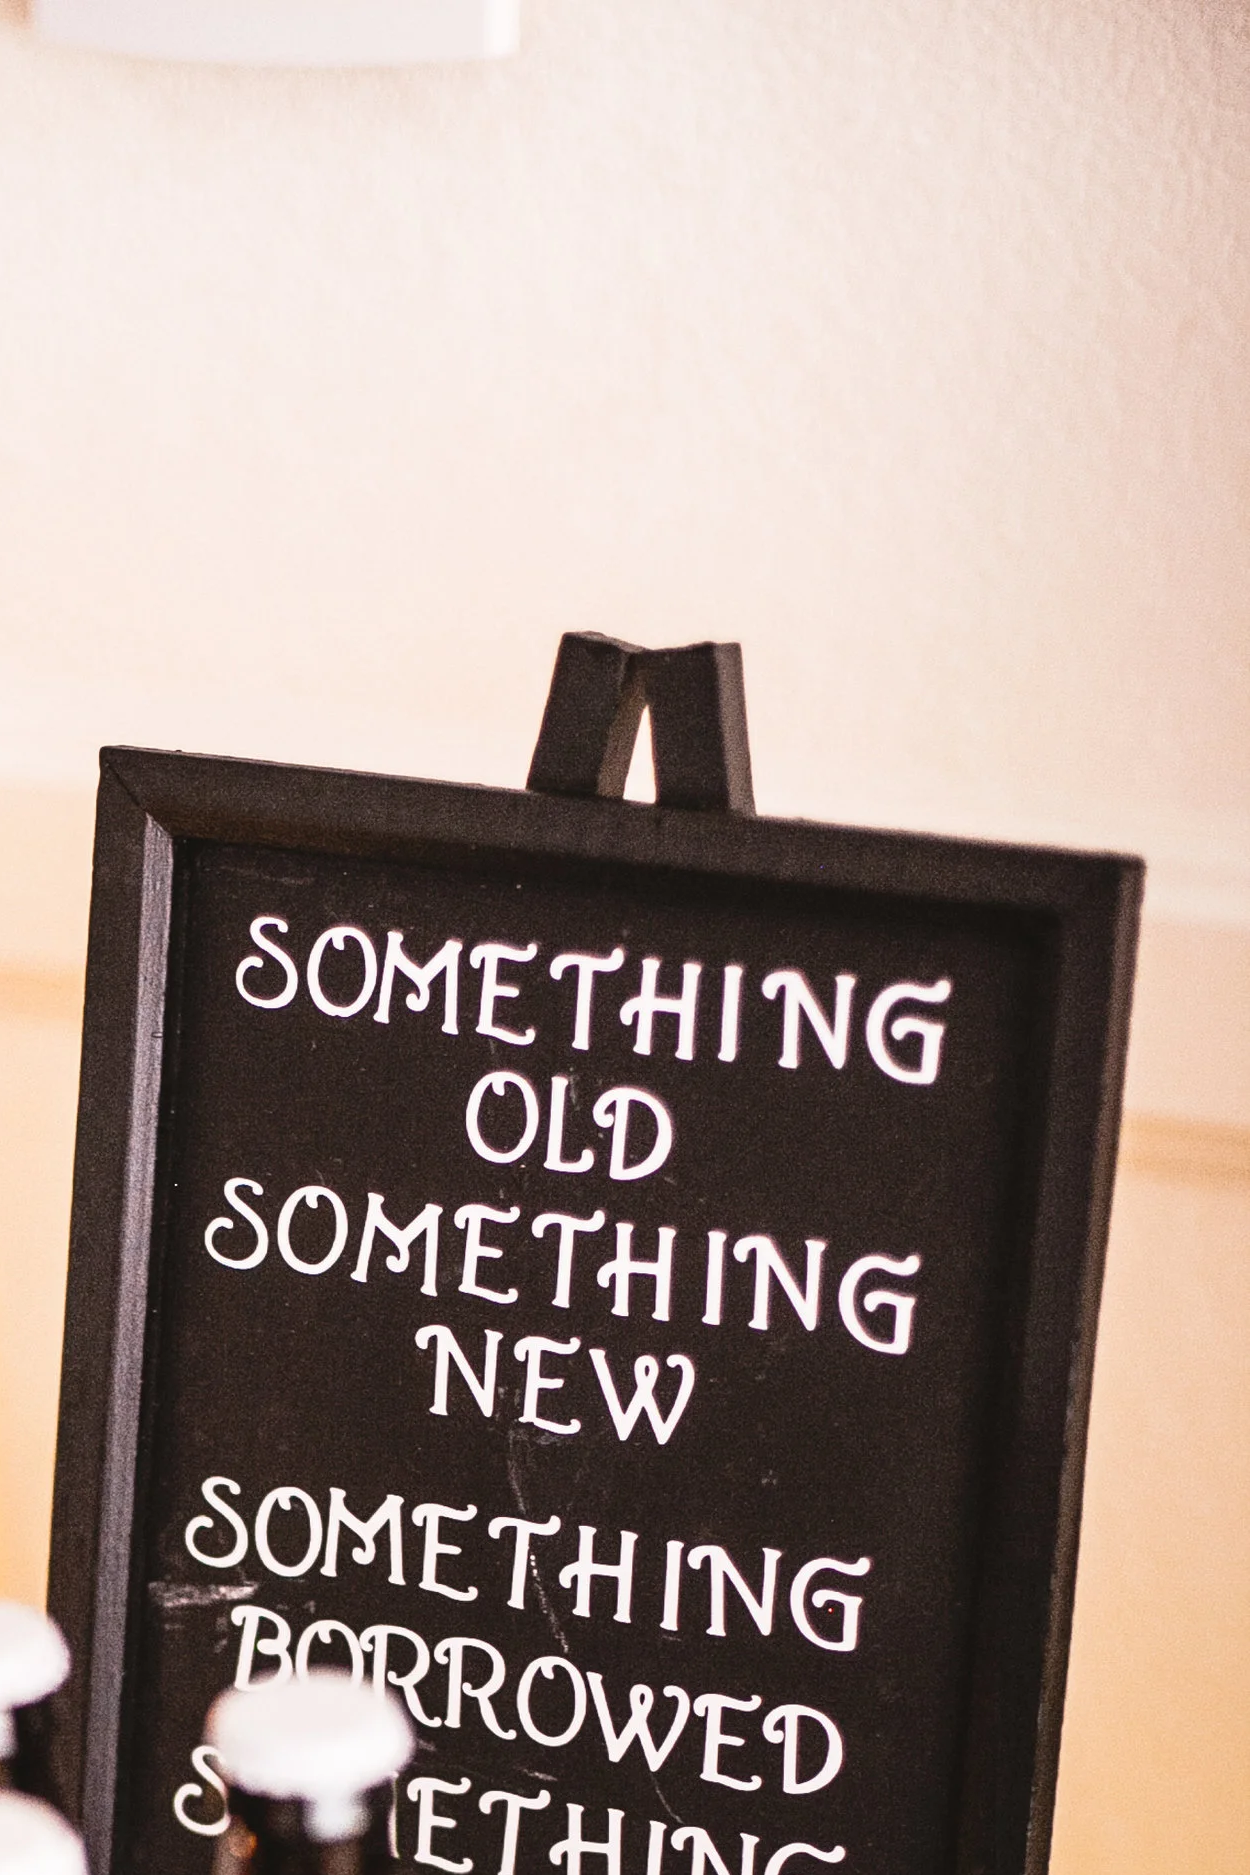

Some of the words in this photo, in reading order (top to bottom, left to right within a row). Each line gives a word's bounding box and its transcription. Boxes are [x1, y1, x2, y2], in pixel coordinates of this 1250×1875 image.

[235, 915, 952, 1086] SOMETHING
[465, 1070, 674, 1181] OLD
[204, 1176, 921, 1355] SOMETHING
[414, 1324, 696, 1445] NEW
[184, 1475, 871, 1652] SOMETHING
[231, 1605, 844, 1795] BORROWED
